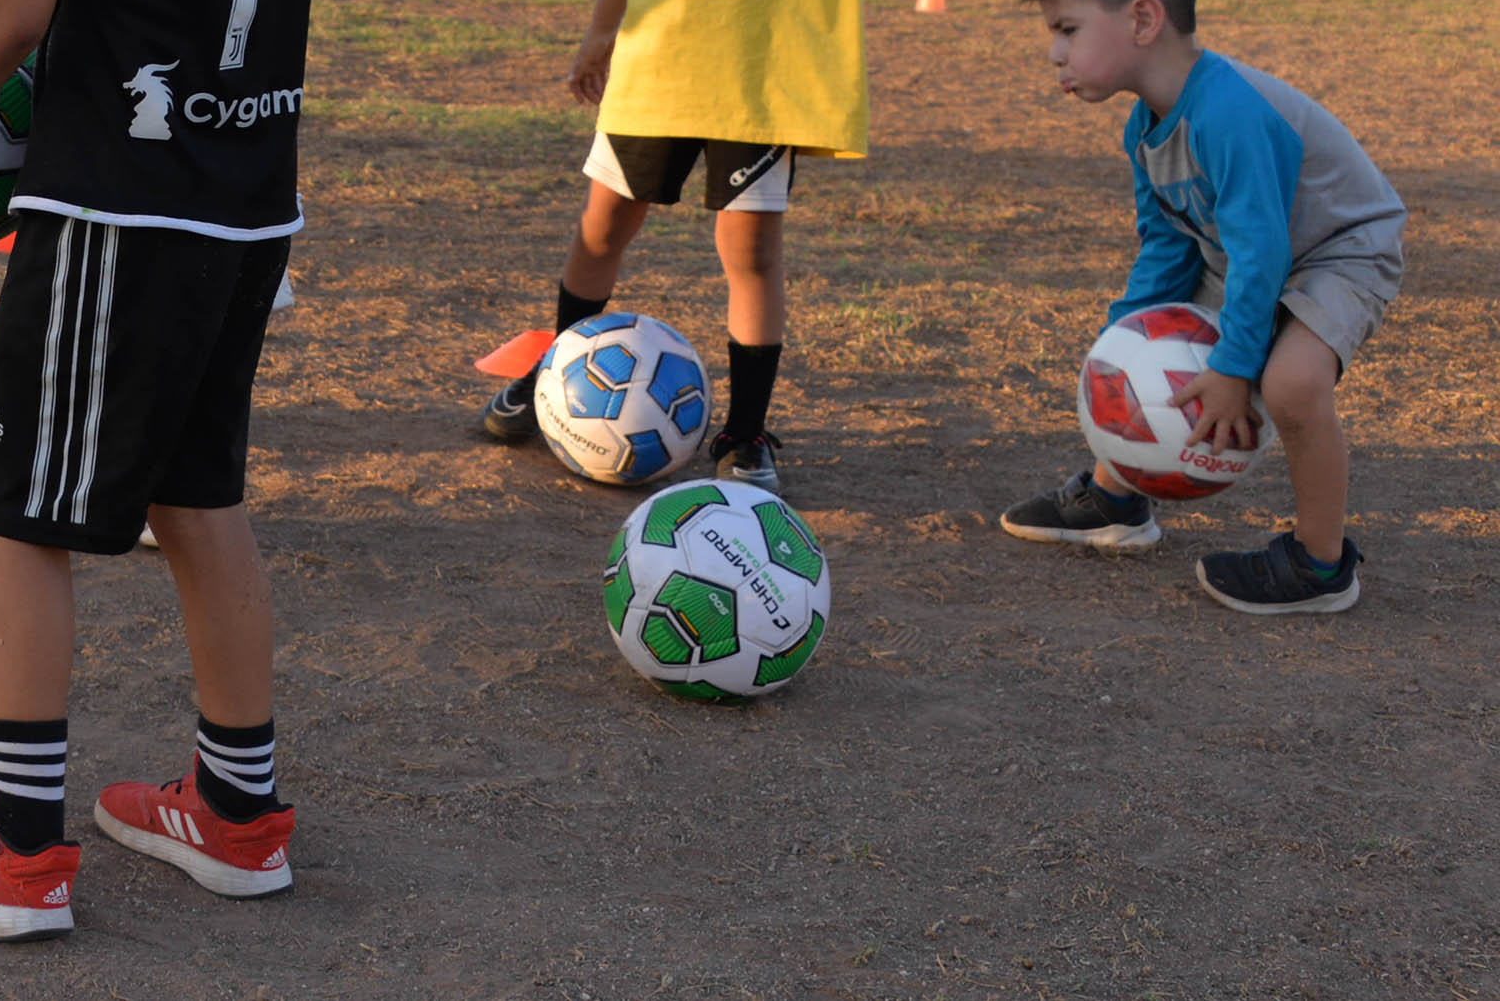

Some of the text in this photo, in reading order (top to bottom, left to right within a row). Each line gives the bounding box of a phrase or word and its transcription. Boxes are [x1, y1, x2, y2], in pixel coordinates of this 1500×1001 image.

[184, 87, 304, 129] Cygam
[1180, 448, 1250, 474] molten
[704, 529, 779, 615] CHAMPRO
[708, 591, 730, 616] 500
